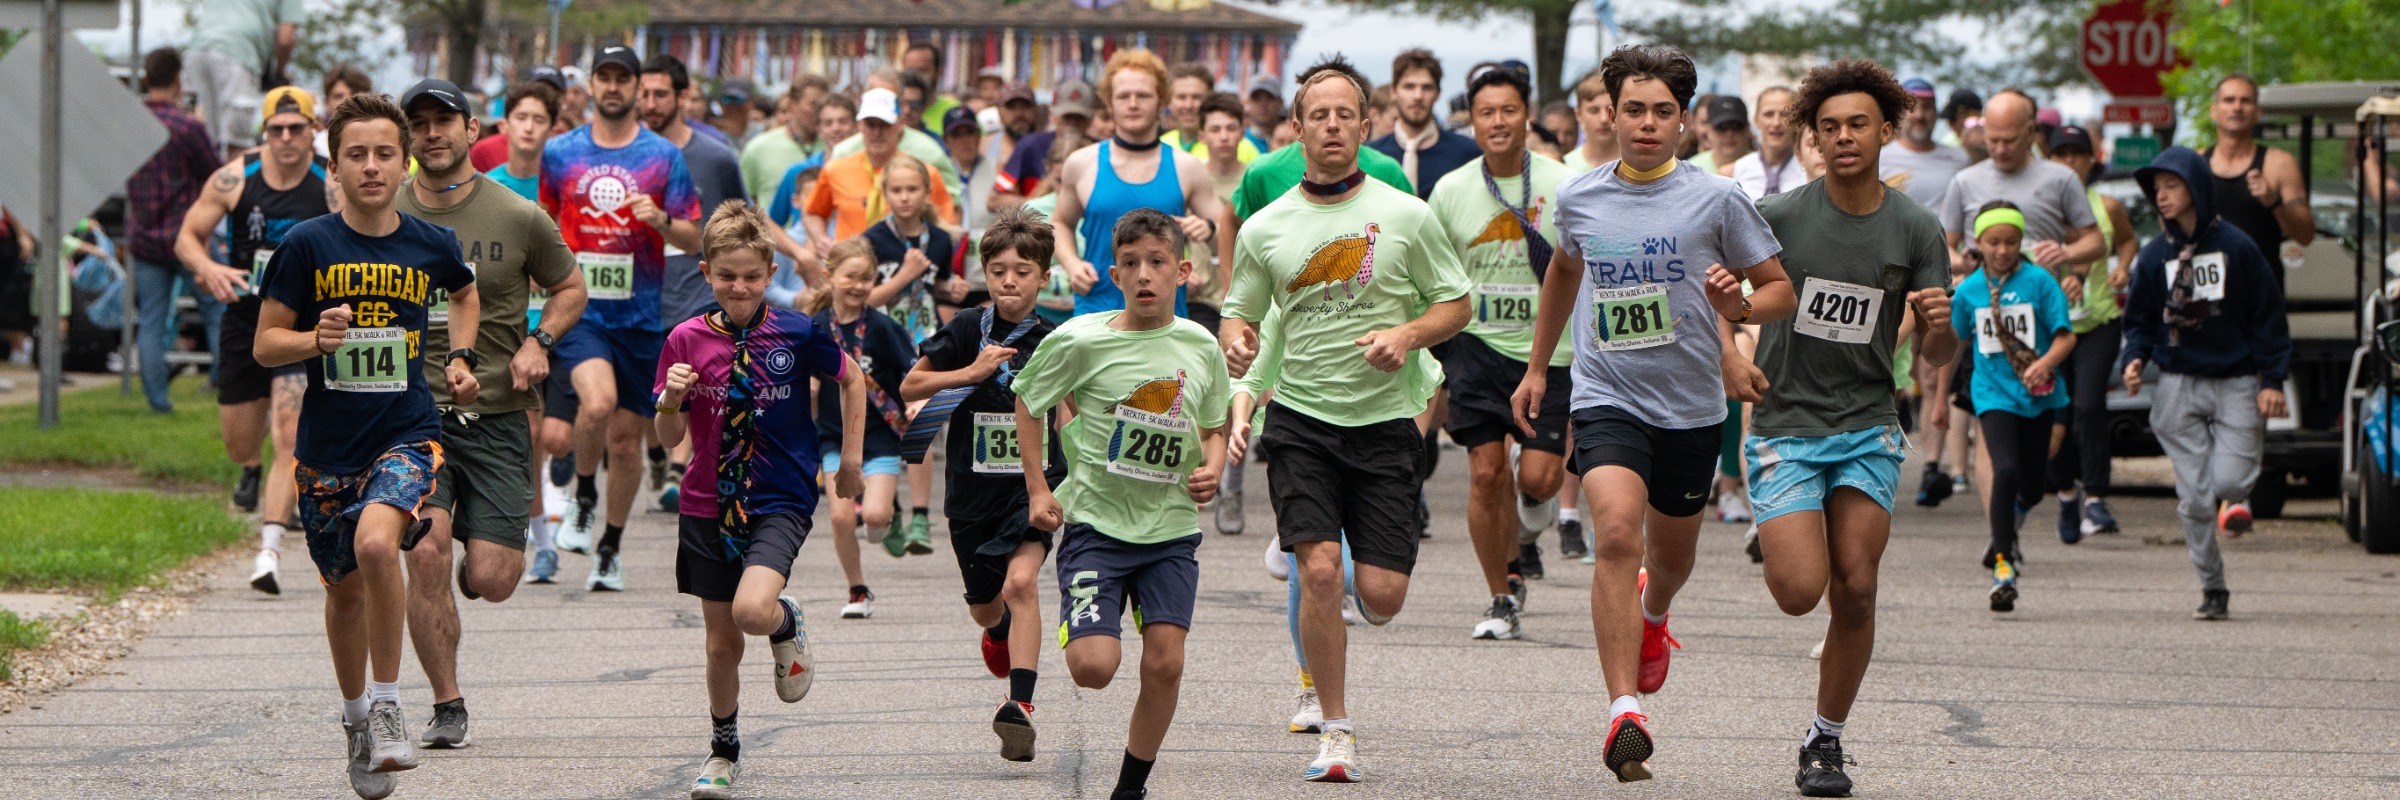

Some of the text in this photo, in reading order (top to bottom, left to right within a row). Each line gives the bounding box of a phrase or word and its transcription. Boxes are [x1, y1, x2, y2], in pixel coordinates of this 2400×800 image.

[576, 163, 611, 194] UNITED
[315, 262, 430, 307] MICHIGAN
[590, 266, 626, 288] 163
[1587, 259, 1686, 285] TRAILS
[1625, 288, 1641, 298] WALK
[1336, 301, 1375, 313] Shores
[1492, 297, 1531, 320] 129
[1611, 300, 1663, 336] 281
[1807, 291, 1870, 326] 4201
[363, 331, 381, 339] WALK
[385, 330, 397, 338] RUN
[1983, 314, 2028, 338] 404
[346, 346, 395, 377] 114
[1122, 407, 1147, 422] NECKTIE
[1149, 415, 1157, 424] 5K
[1157, 418, 1174, 428] WALK
[1123, 428, 1183, 468] 285
